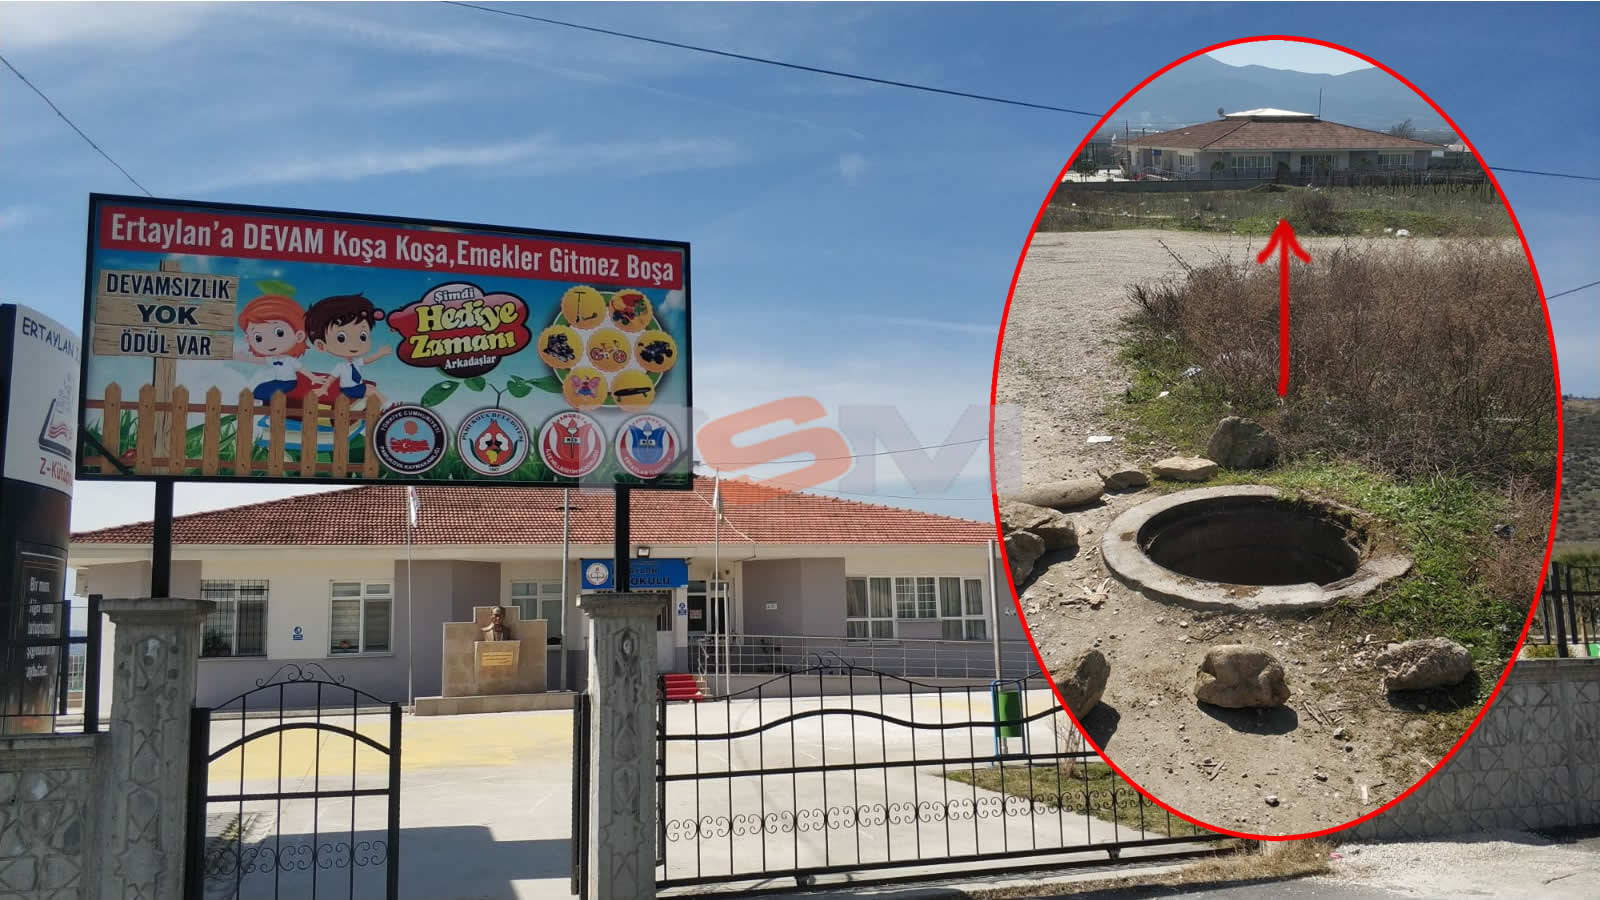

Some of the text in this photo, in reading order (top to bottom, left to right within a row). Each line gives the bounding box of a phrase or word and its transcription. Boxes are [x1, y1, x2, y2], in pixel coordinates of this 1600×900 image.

[243, 223, 324, 255] DEVAM
[333, 229, 387, 264] Koşa
[550, 247, 619, 278] Gitmez
[627, 254, 674, 286] Boşa
[105, 272, 231, 300] DEVAMSIZLIK
[432, 287, 475, 303] Şimdi
[136, 303, 198, 326] YOK
[414, 298, 519, 333] Hediye
[22, 316, 74, 358] ERTAYLAN
[120, 328, 212, 356] ÖDÜL VAR
[409, 330, 517, 360] Zamanı
[444, 354, 497, 370] Arkadaşlar
